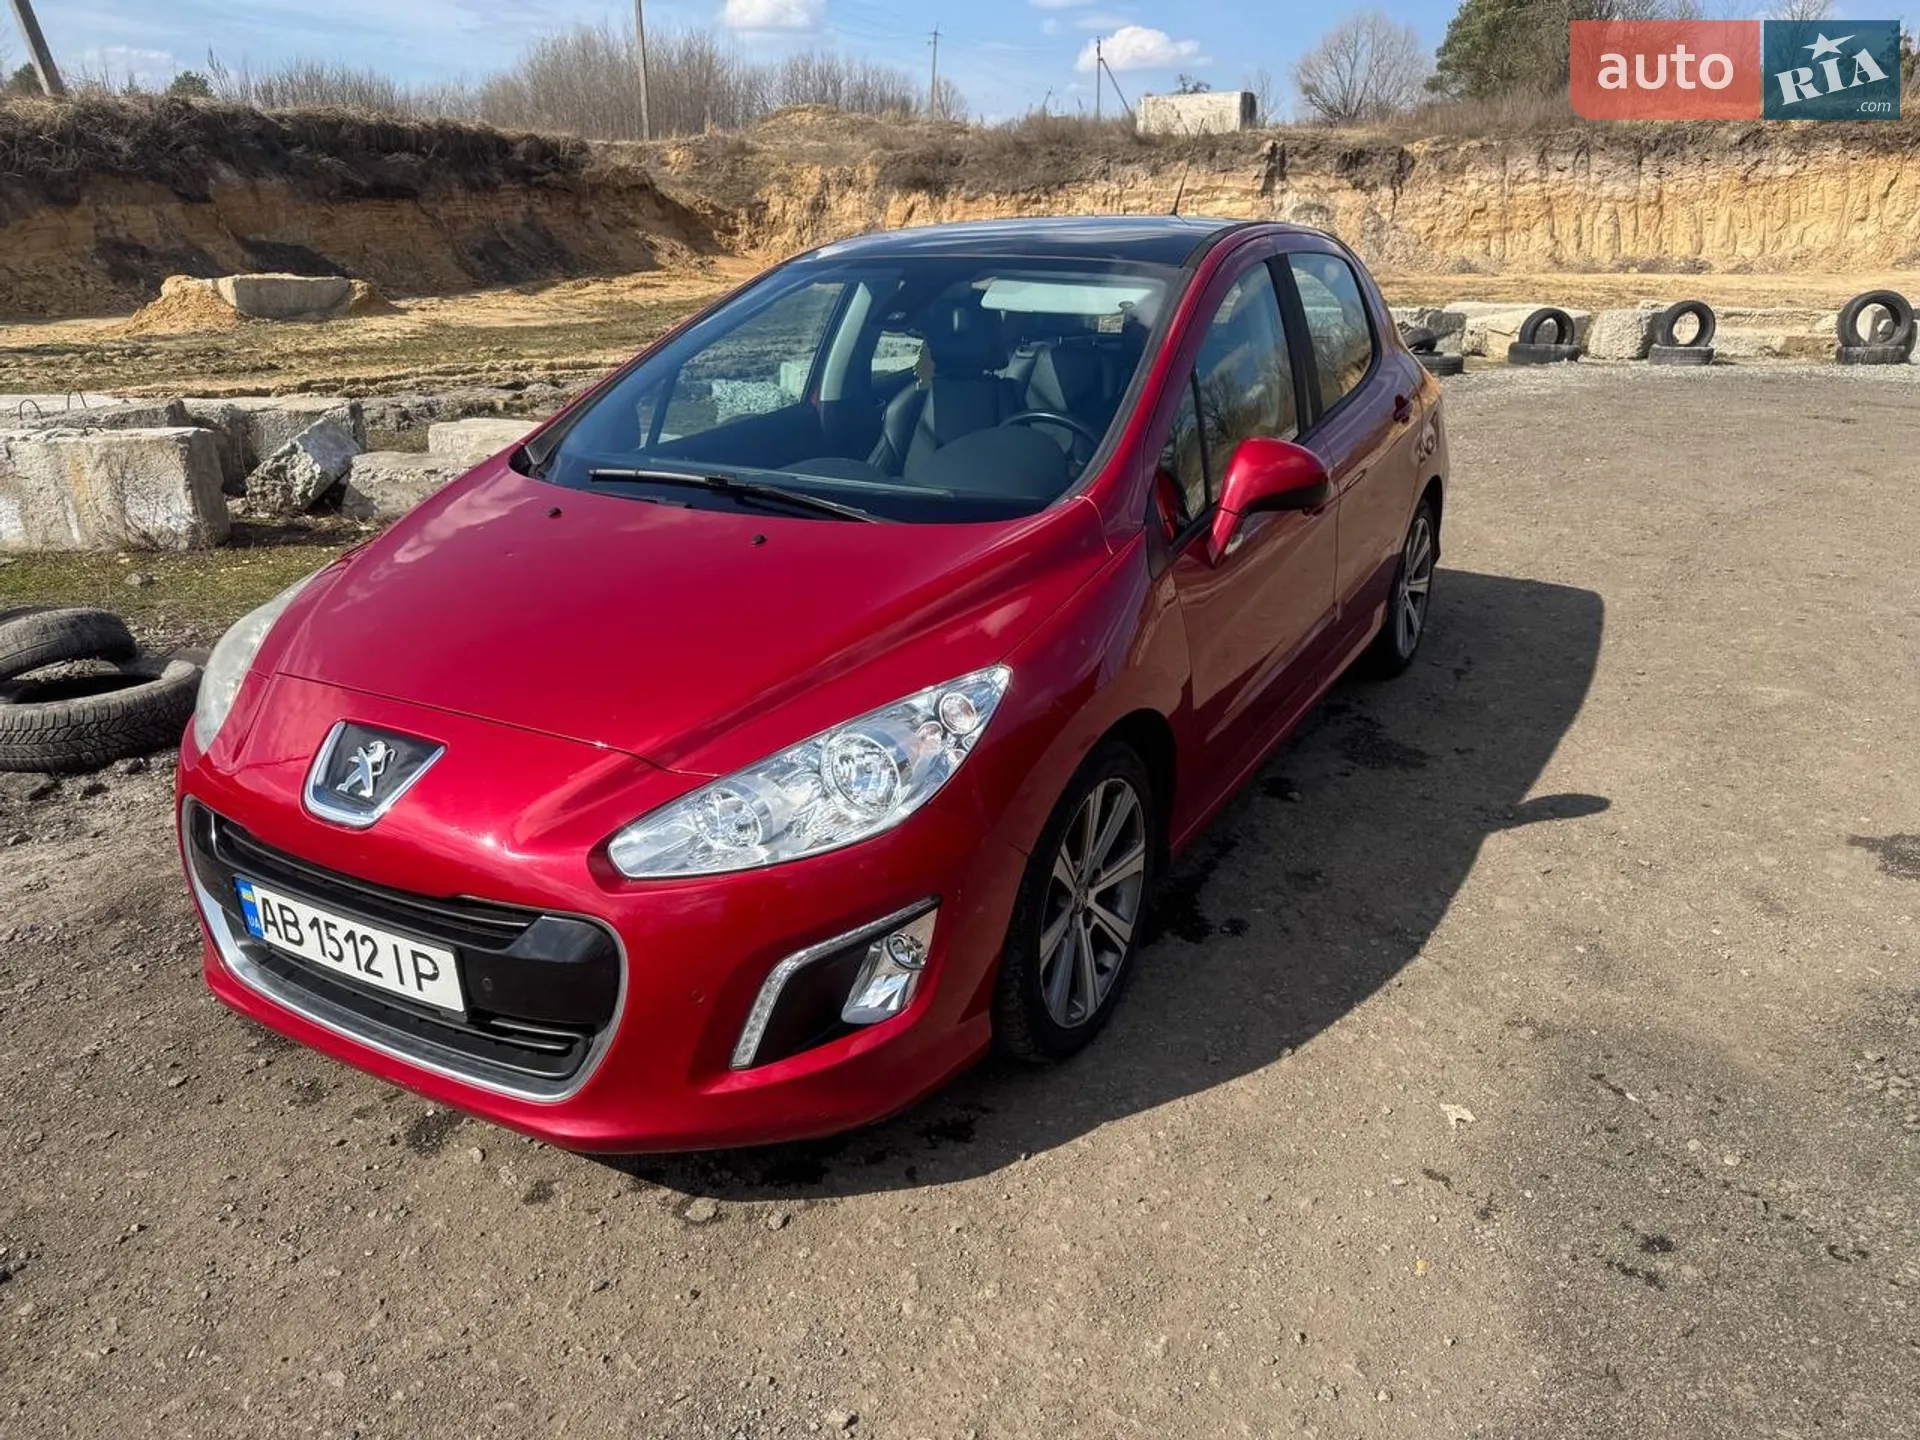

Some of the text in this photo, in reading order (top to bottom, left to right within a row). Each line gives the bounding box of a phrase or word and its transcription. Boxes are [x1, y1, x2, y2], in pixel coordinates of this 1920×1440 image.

[261, 897, 440, 992] AB 1512 IP
